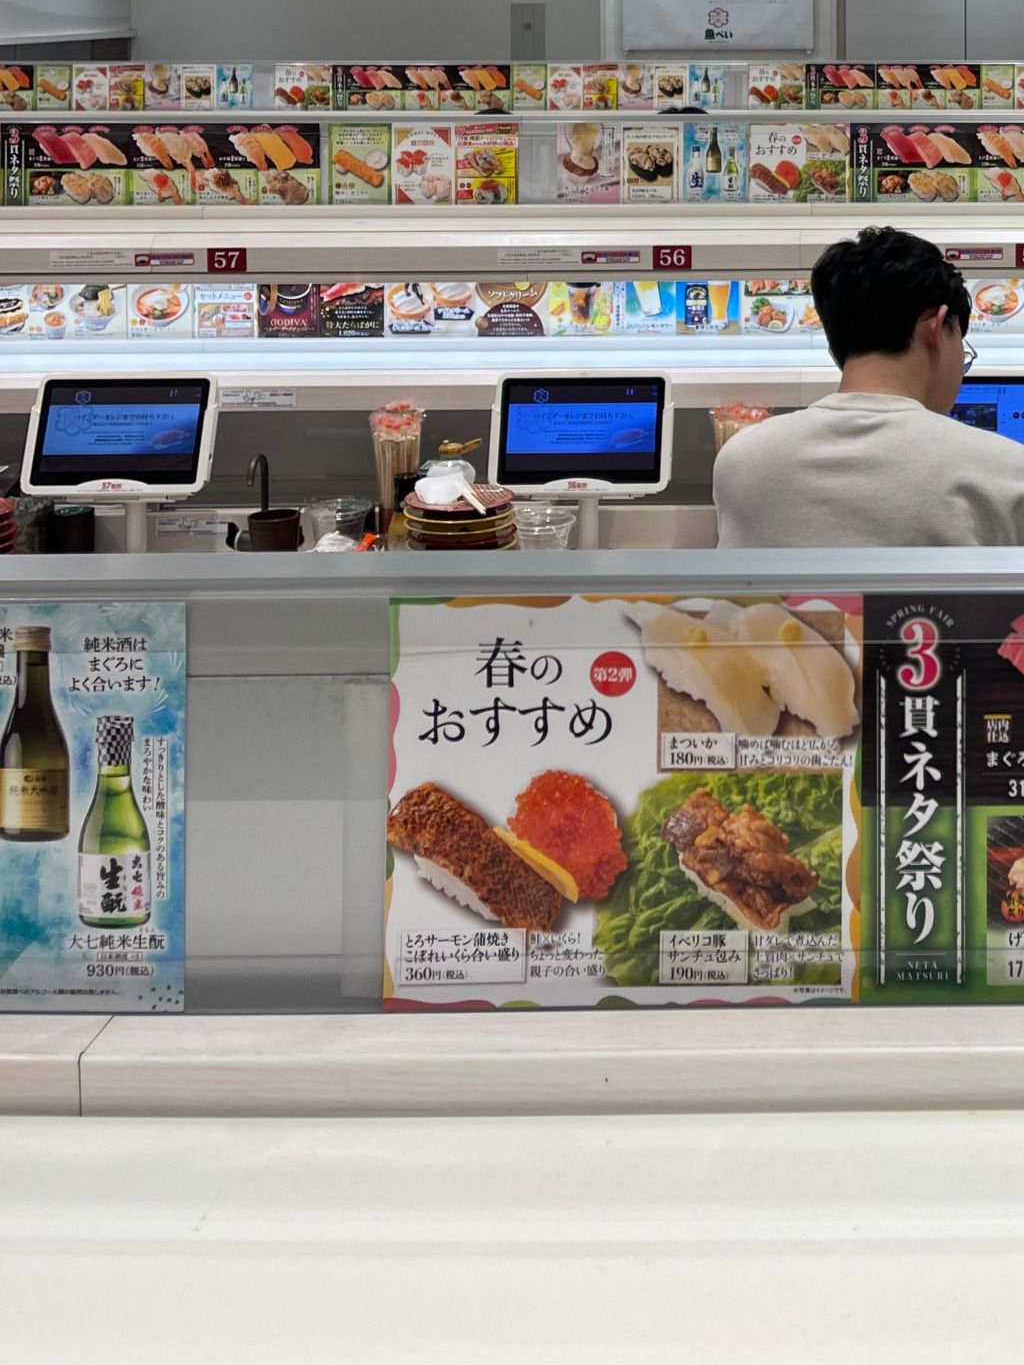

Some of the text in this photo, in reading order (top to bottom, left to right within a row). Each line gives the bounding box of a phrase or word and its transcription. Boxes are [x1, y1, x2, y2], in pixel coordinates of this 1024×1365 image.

[704, 28, 733, 40] 魚べい
[755, 144, 797, 156] おすすめ
[214, 251, 240, 268] 57
[659, 249, 686, 266] 56
[199, 292, 242, 301] セットメニュー
[270, 319, 307, 328] GODIVA
[886, 603, 955, 629] SPRING FAIR
[84, 637, 147, 652] 純米酒は
[88, 657, 143, 672] まぐろに
[474, 637, 563, 688] 春の
[592, 666, 633, 683] 第2弾
[69, 676, 160, 692] よく合います!
[418, 696, 612, 747] おすすめ
[670, 737, 718, 749] まついか
[738, 739, 839, 750] 噛めば噛むほど広がる
[670, 752, 729, 765] 180円(税込)
[142, 737, 153, 811] まろやかな味わい
[896, 618, 947, 945] 3貫ネタ祭り
[156, 737, 166, 898] すっきりとした酸味とコクのある旨みの
[68, 934, 165, 950] 大七純米生酛
[405, 932, 509, 948] とろサーモン蒲焼き
[668, 933, 726, 948] イベリコ豚
[754, 935, 838, 947] 甘ダレで煮込んだ
[405, 947, 520, 963] こぼれいくら合い盛り
[529, 950, 604, 961] ちょっと変わった
[667, 949, 741, 963] サンチュ包み
[87, 964, 155, 977] 930円(税込)
[529, 964, 606, 978] 親子の合い盛り
[907, 961, 938, 970] NETA
[405, 967, 468, 980] 360円(税込)
[670, 966, 729, 981] 190円(税込)
[753, 967, 793, 980] さっぱり!
[897, 971, 950, 981] MATSURI
